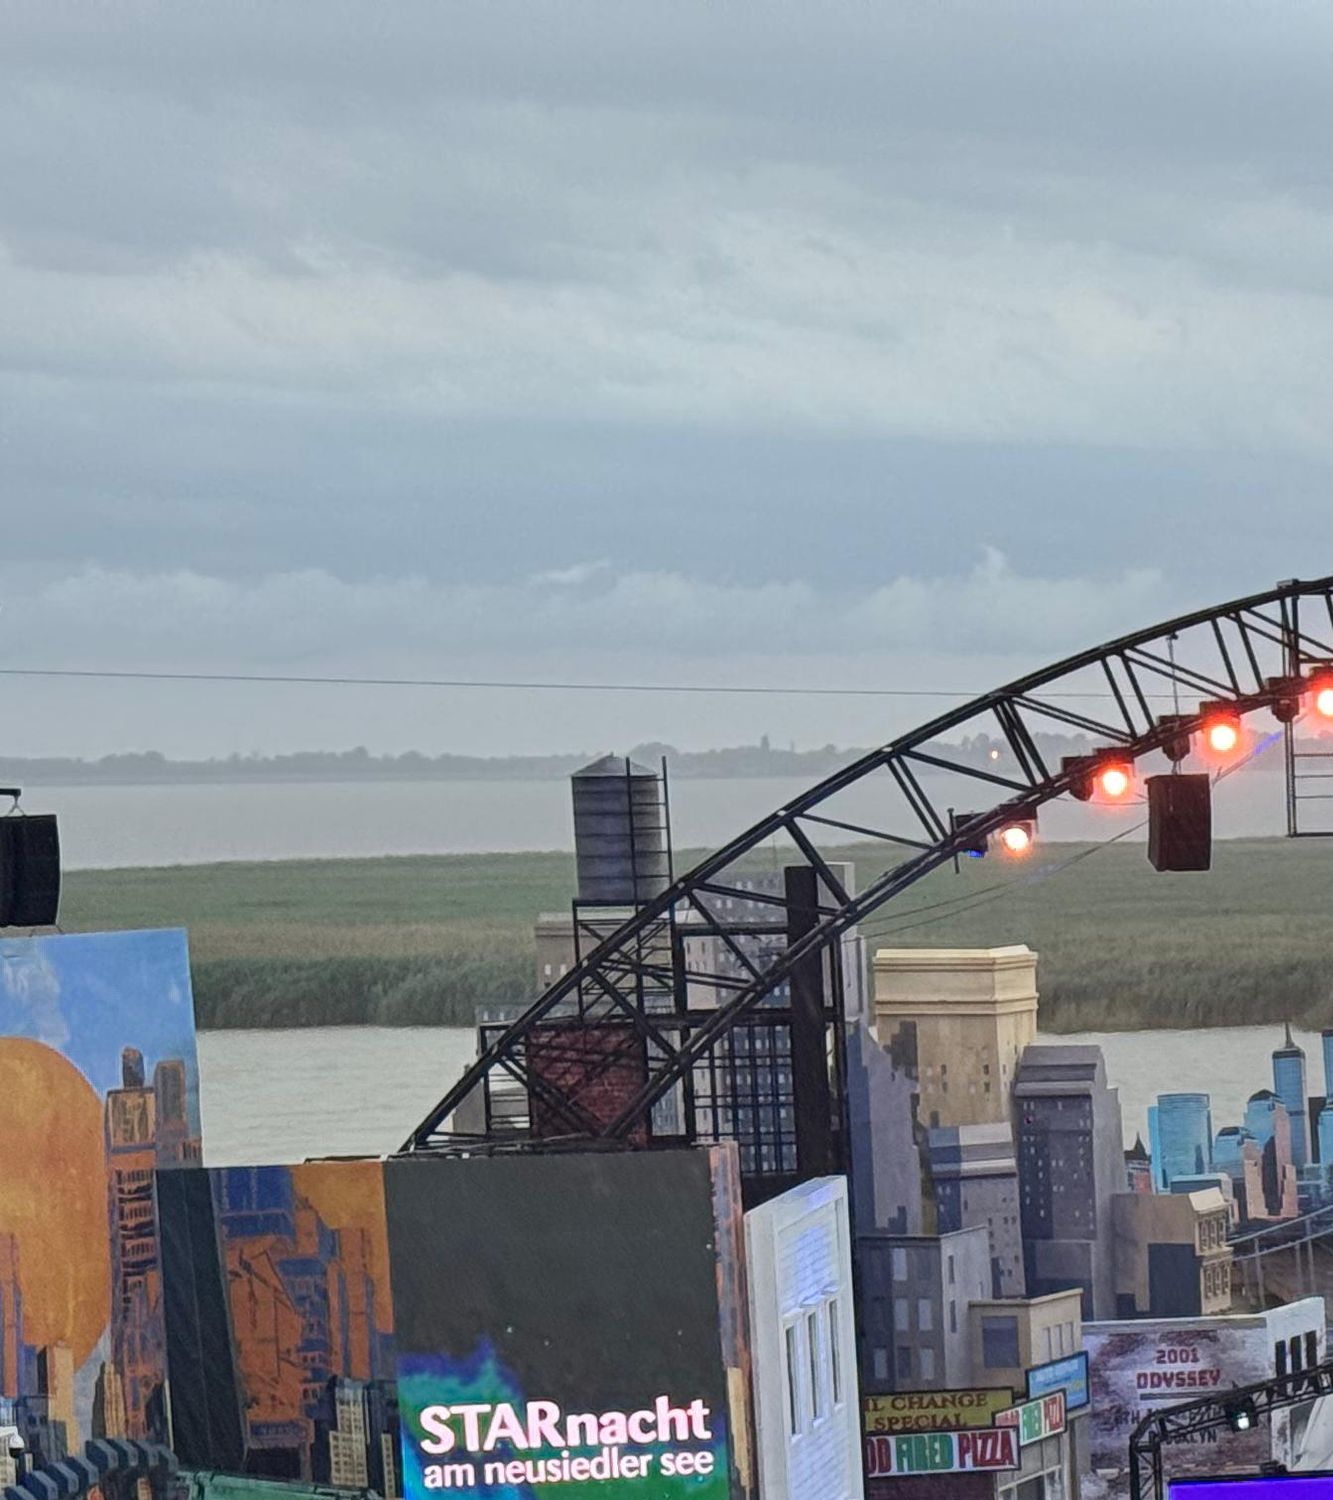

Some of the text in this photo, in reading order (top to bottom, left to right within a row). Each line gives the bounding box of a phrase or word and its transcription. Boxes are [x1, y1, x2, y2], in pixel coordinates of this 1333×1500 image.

[1155, 1348, 1200, 1365] 2001
[864, 1392, 989, 1413] IL CHANGE
[420, 1395, 712, 1454] STARnacht
[874, 1412, 967, 1431] SPECIAL
[896, 1433, 954, 1472] FIRED
[957, 1430, 1016, 1468] PIZZA
[424, 1447, 714, 1489] am neusiedler see
